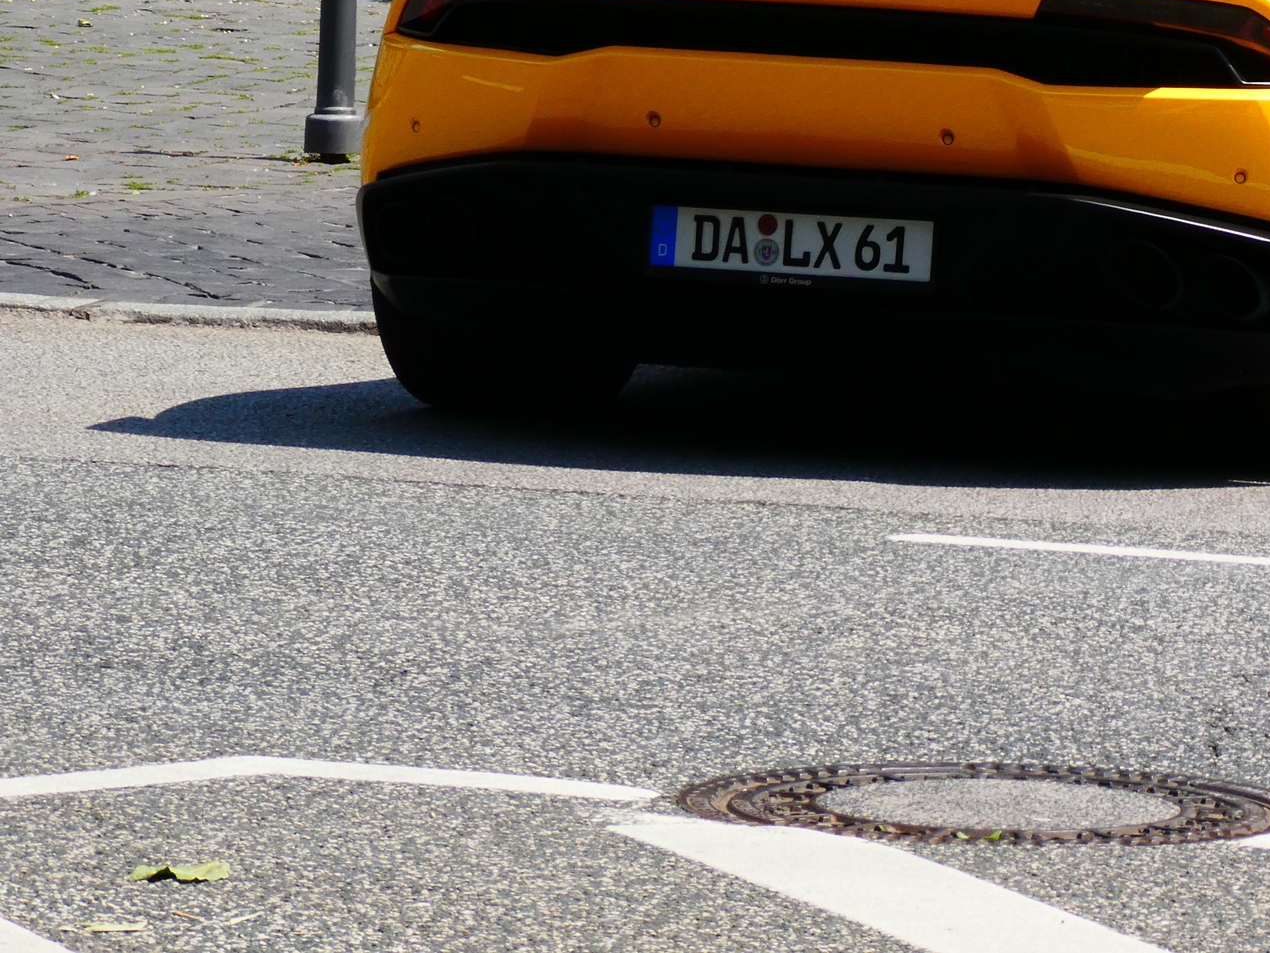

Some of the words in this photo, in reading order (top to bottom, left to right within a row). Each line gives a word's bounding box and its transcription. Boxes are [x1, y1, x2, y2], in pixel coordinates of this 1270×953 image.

[658, 243, 668, 257] D
[692, 214, 749, 264] DA
[782, 219, 843, 269] LX
[854, 224, 910, 273] 61
[789, 277, 812, 286] Group
